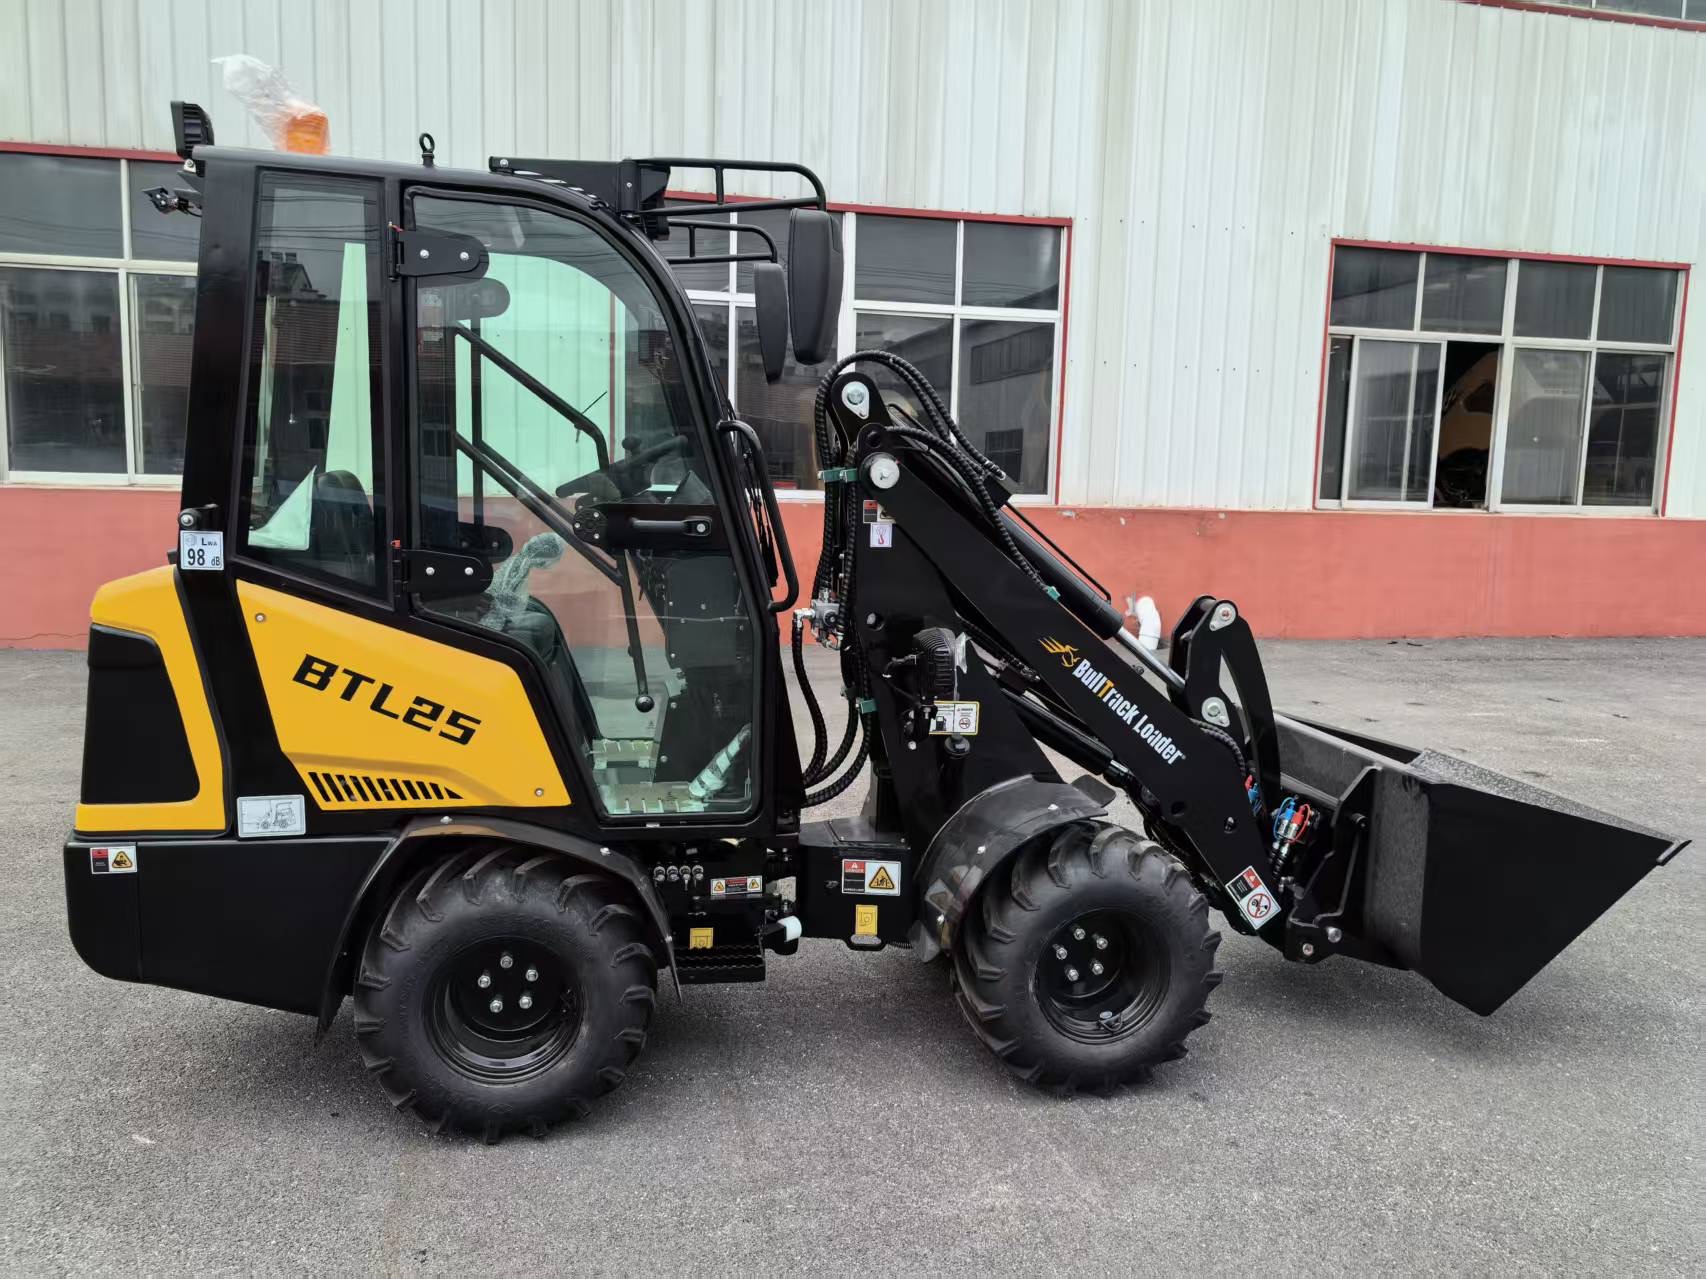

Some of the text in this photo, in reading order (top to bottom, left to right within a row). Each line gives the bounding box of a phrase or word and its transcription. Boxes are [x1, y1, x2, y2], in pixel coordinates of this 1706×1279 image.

[187, 548, 221, 566] 98 dB
[292, 653, 482, 746] BTL25
[1072, 658, 1183, 765] BullTrack Loader
